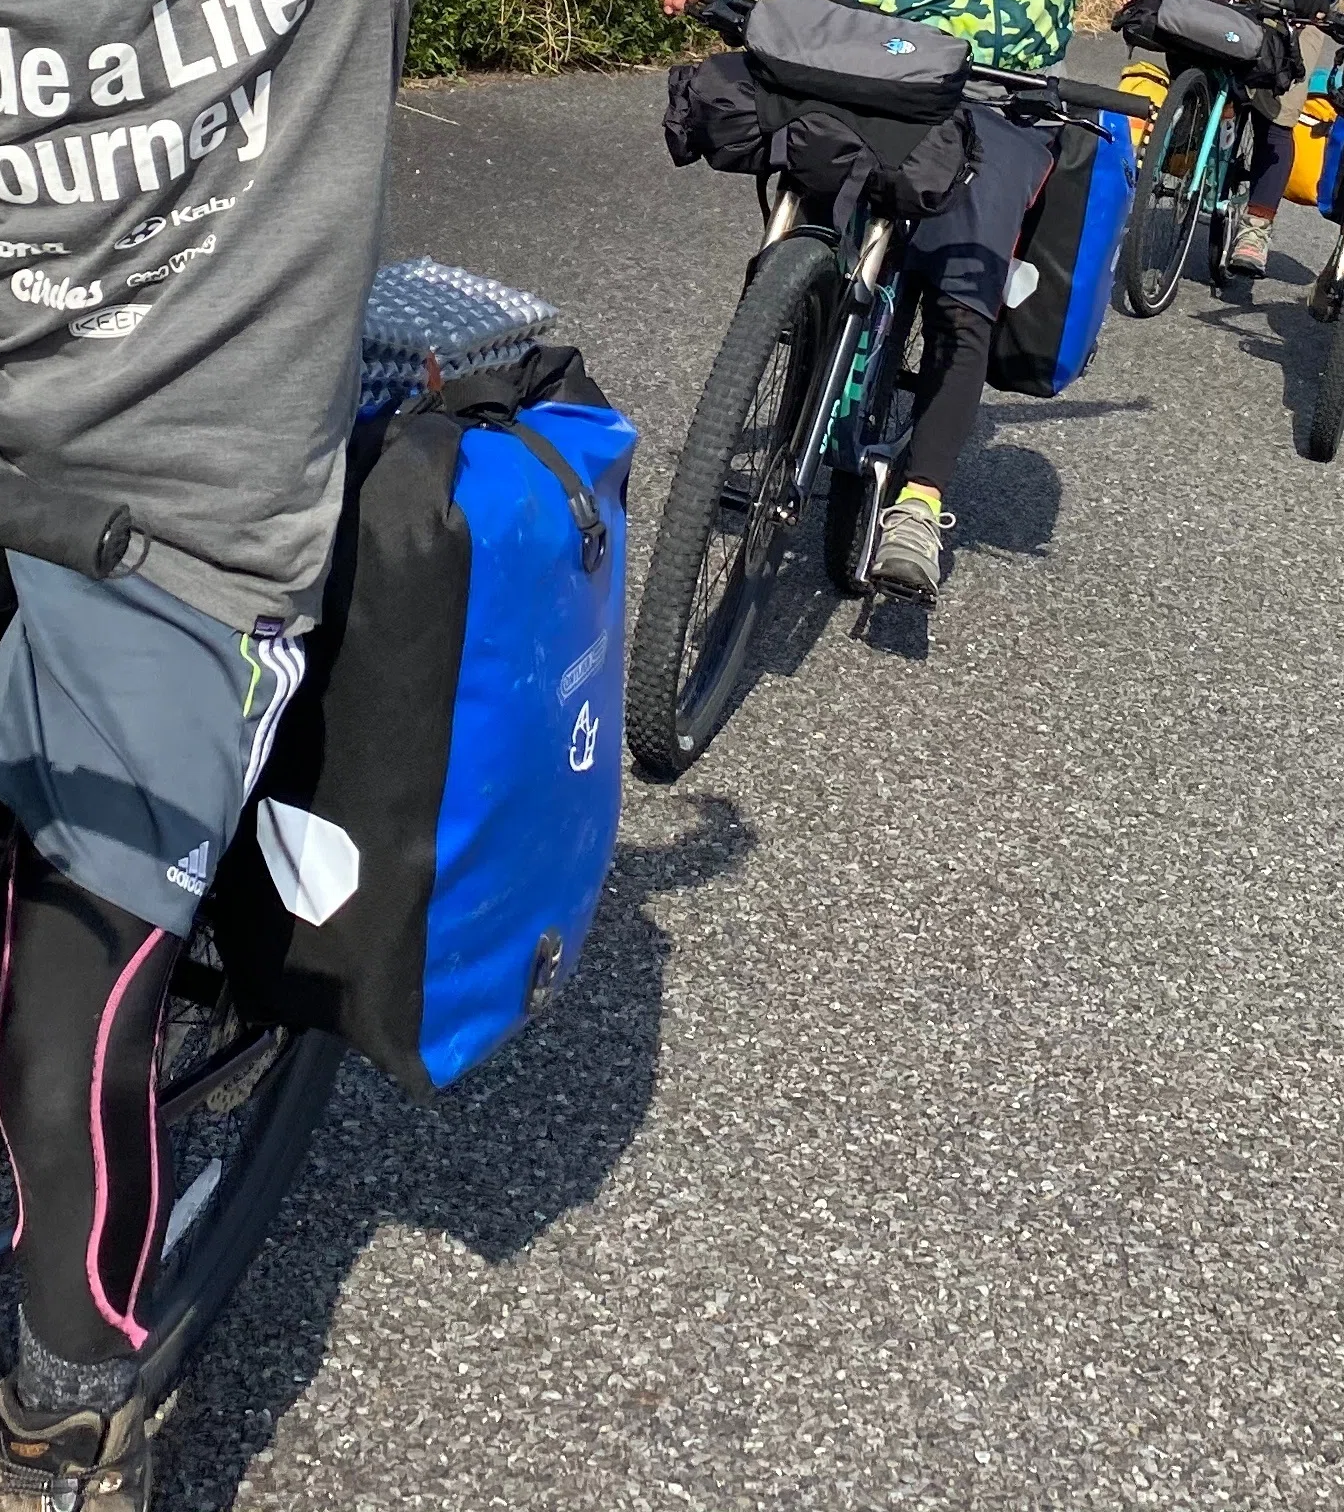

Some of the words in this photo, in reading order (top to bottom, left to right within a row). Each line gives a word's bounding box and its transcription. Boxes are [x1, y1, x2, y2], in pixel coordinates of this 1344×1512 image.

[89, 42, 145, 107] a
[171, 188, 248, 226] Kabu
[167, 865, 206, 897] adida
